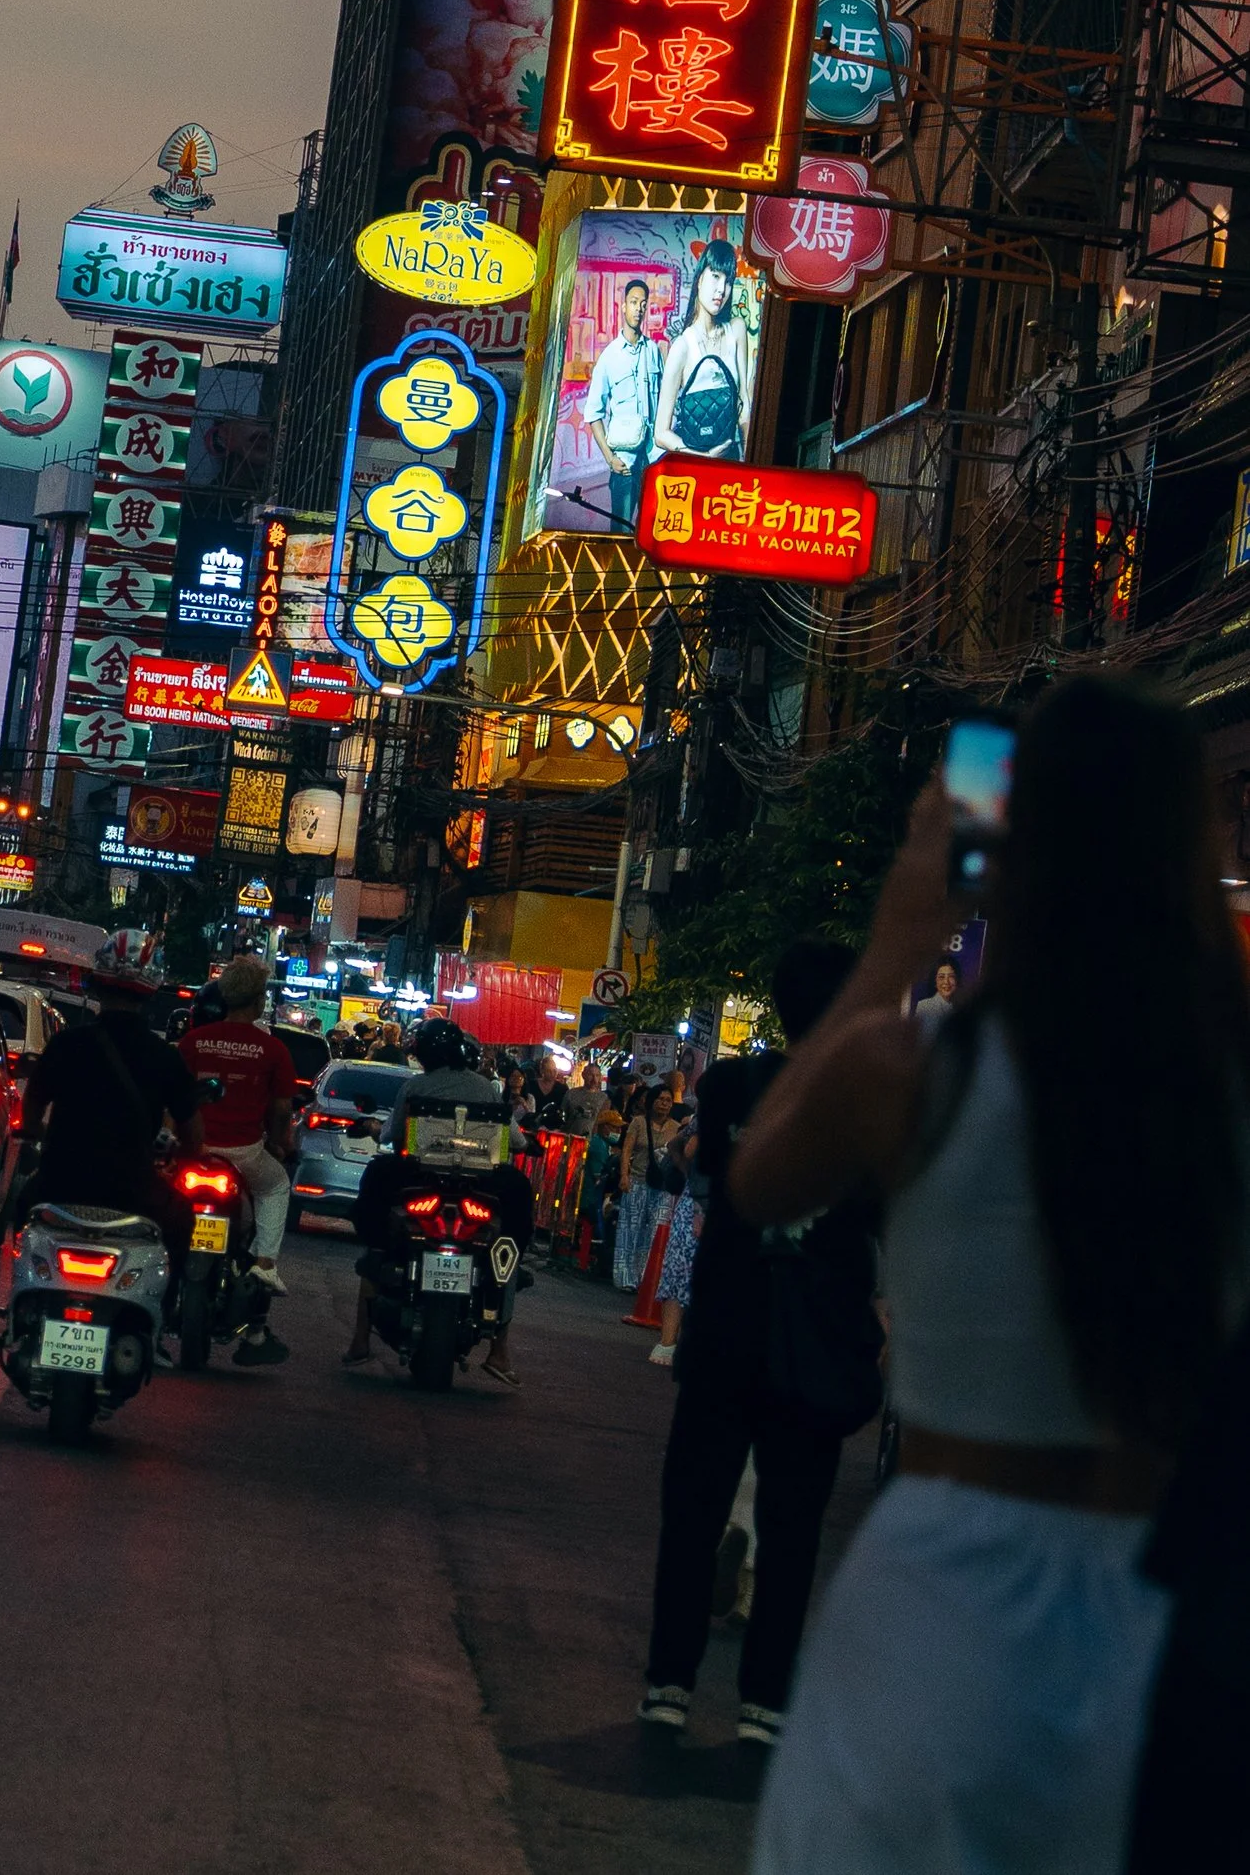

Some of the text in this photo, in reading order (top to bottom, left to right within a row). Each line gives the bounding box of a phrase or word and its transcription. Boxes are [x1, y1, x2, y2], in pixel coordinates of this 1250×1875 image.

[809, 22, 879, 94] 媽
[783, 197, 855, 262] 媽
[121, 235, 228, 266] ห้างขายทอง
[383, 233, 504, 286] NaRaYa
[73, 241, 270, 318] ฮั่วเซ่งเฮง
[379, 378, 453, 645] 曼谷包
[657, 481, 691, 535] 四姐
[81, 342, 180, 761] 和成興大金行
[699, 528, 857, 558] JAESI YAOWARAT
[179, 589, 217, 606] Hotel
[134, 666, 188, 688] ร้านขายยา
[129, 703, 268, 729] LIM SOON HENG NATURAL MEDICINE
[195, 1039, 265, 1055] BALENCIAGA
[432, 1279, 460, 1291] 857
[50, 1352, 97, 1370] 5298
